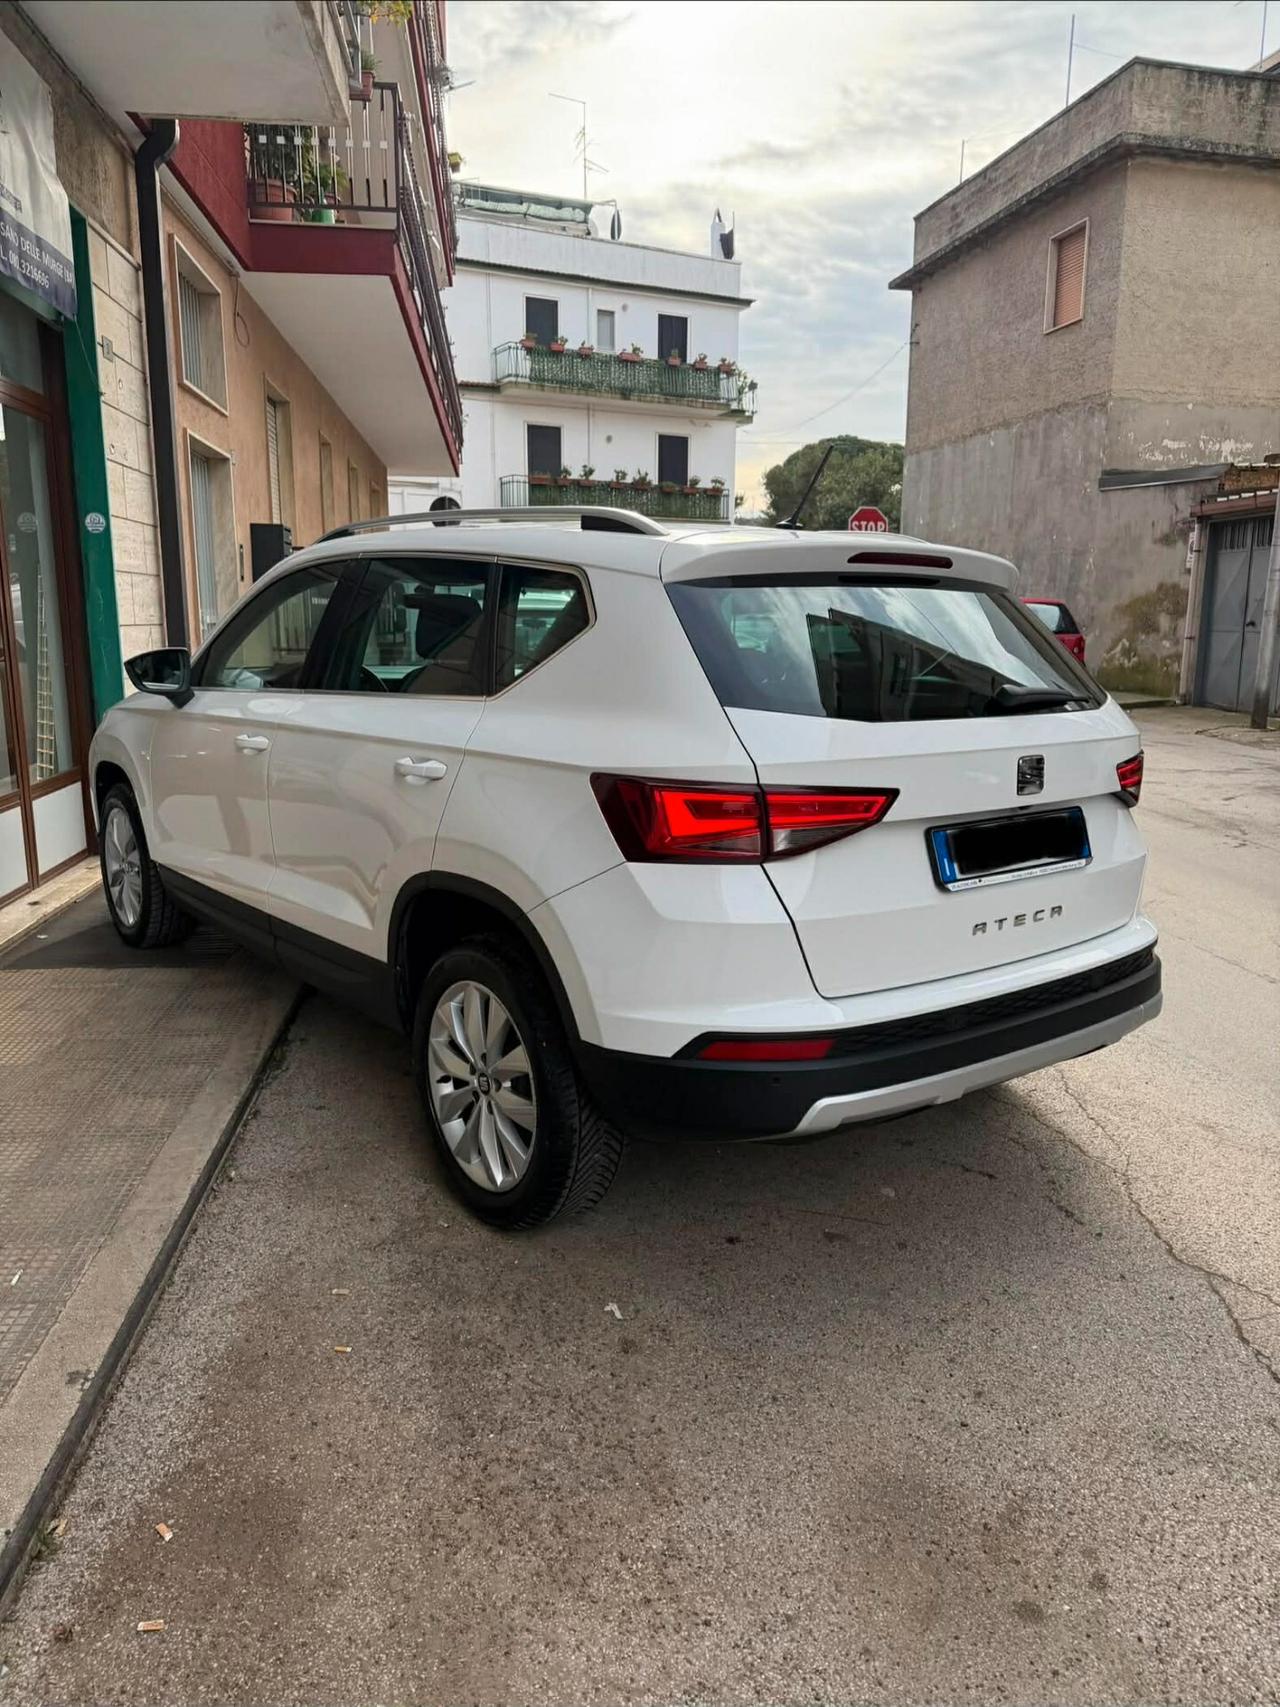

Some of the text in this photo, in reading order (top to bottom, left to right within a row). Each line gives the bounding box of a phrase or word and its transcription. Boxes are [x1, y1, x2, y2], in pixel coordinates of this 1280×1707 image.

[20, 236, 42, 262] DELLE
[42, 250, 64, 278] MURGE
[851, 520, 886, 532] STOP
[972, 904, 1062, 936] ATECA
